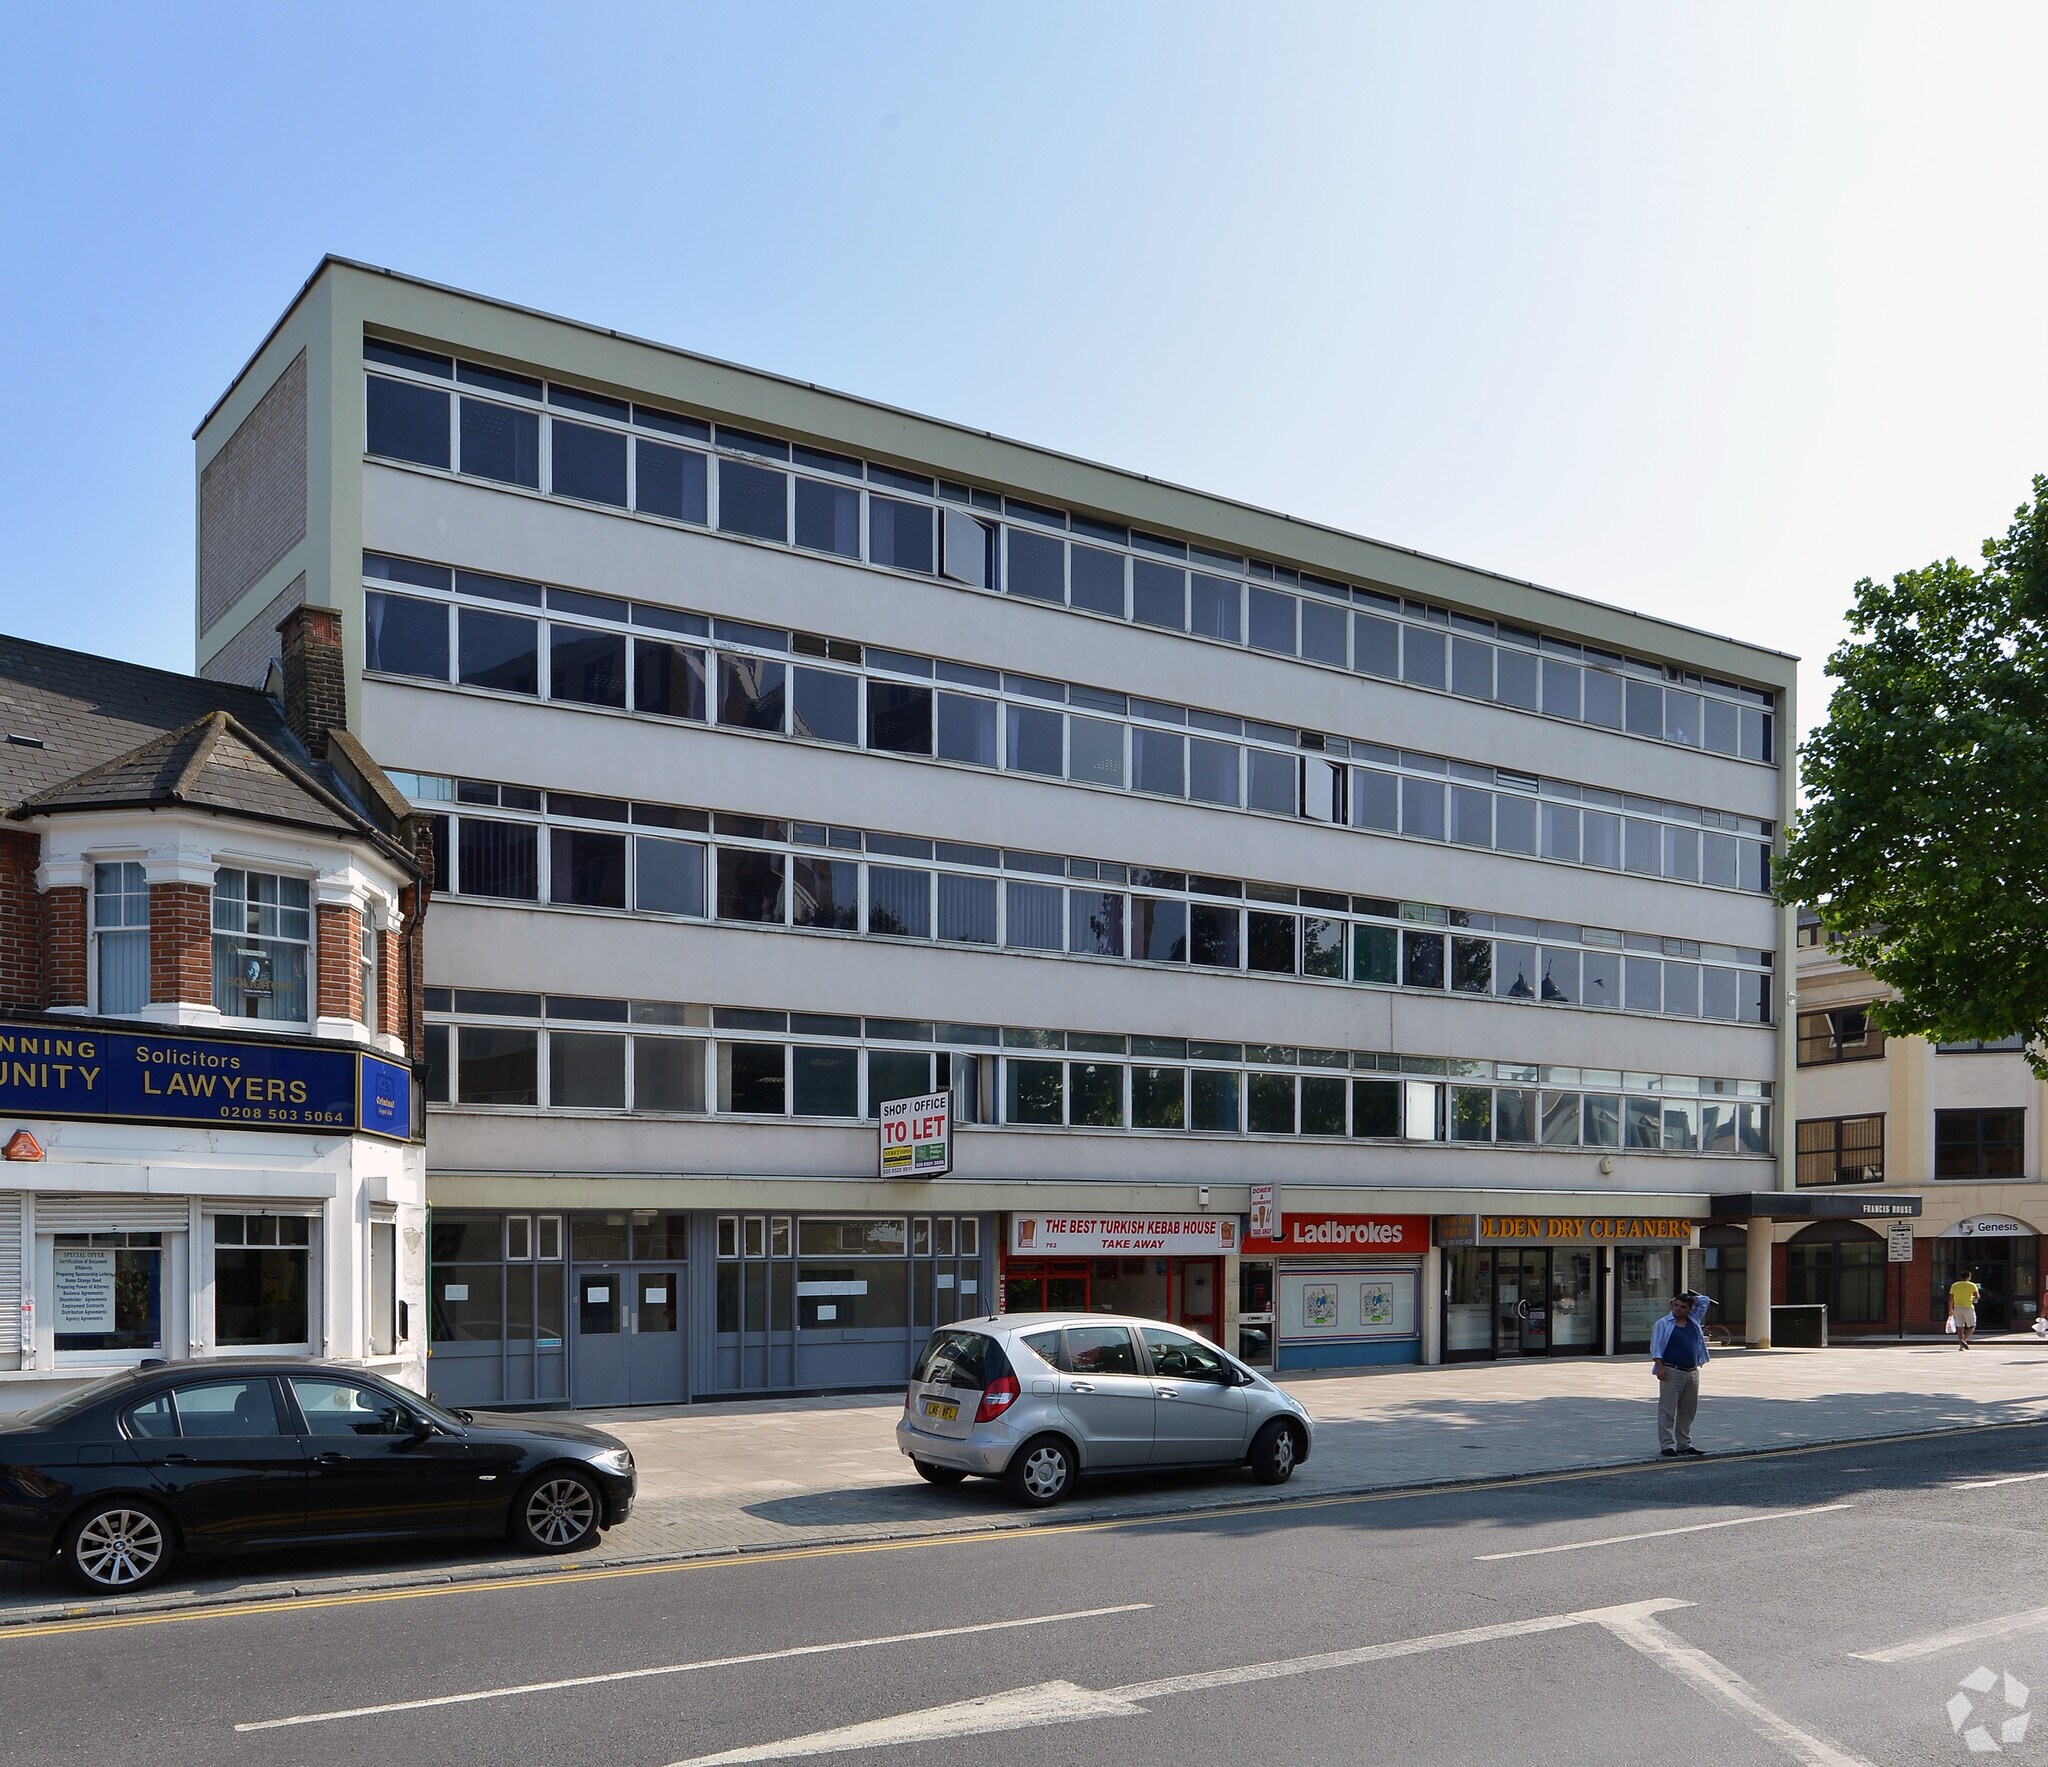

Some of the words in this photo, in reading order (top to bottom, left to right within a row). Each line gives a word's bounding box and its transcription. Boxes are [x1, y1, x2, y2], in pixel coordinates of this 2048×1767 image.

[0, 1036, 95, 1058] NNING
[136, 1046, 240, 1069] Solicitors
[144, 1070, 308, 1104] LAWYERS
[376, 1096, 395, 1108] Criminal
[884, 1104, 907, 1116] SHOP
[914, 1098, 946, 1112] OFFICE
[220, 1106, 262, 1119] 0208
[268, 1109, 298, 1120] 503
[304, 1111, 343, 1122] 5064
[884, 1121, 907, 1143] TO
[913, 1116, 945, 1140] LET
[1046, 1219, 1067, 1233] THE
[1070, 1219, 1097, 1234] BEST
[1100, 1220, 1144, 1234] TURKISH
[1147, 1221, 1180, 1235] KEBAB
[1182, 1221, 1216, 1235] HOUSE
[1294, 1221, 1402, 1243] Ladbrokes
[1546, 1219, 1584, 1238] DRY
[1590, 1219, 1690, 1238] CLEANERS
[1978, 1222, 2018, 1231] Genesis
[1101, 1240, 1130, 1248] TAKE
[1133, 1240, 1164, 1248] AWAY
